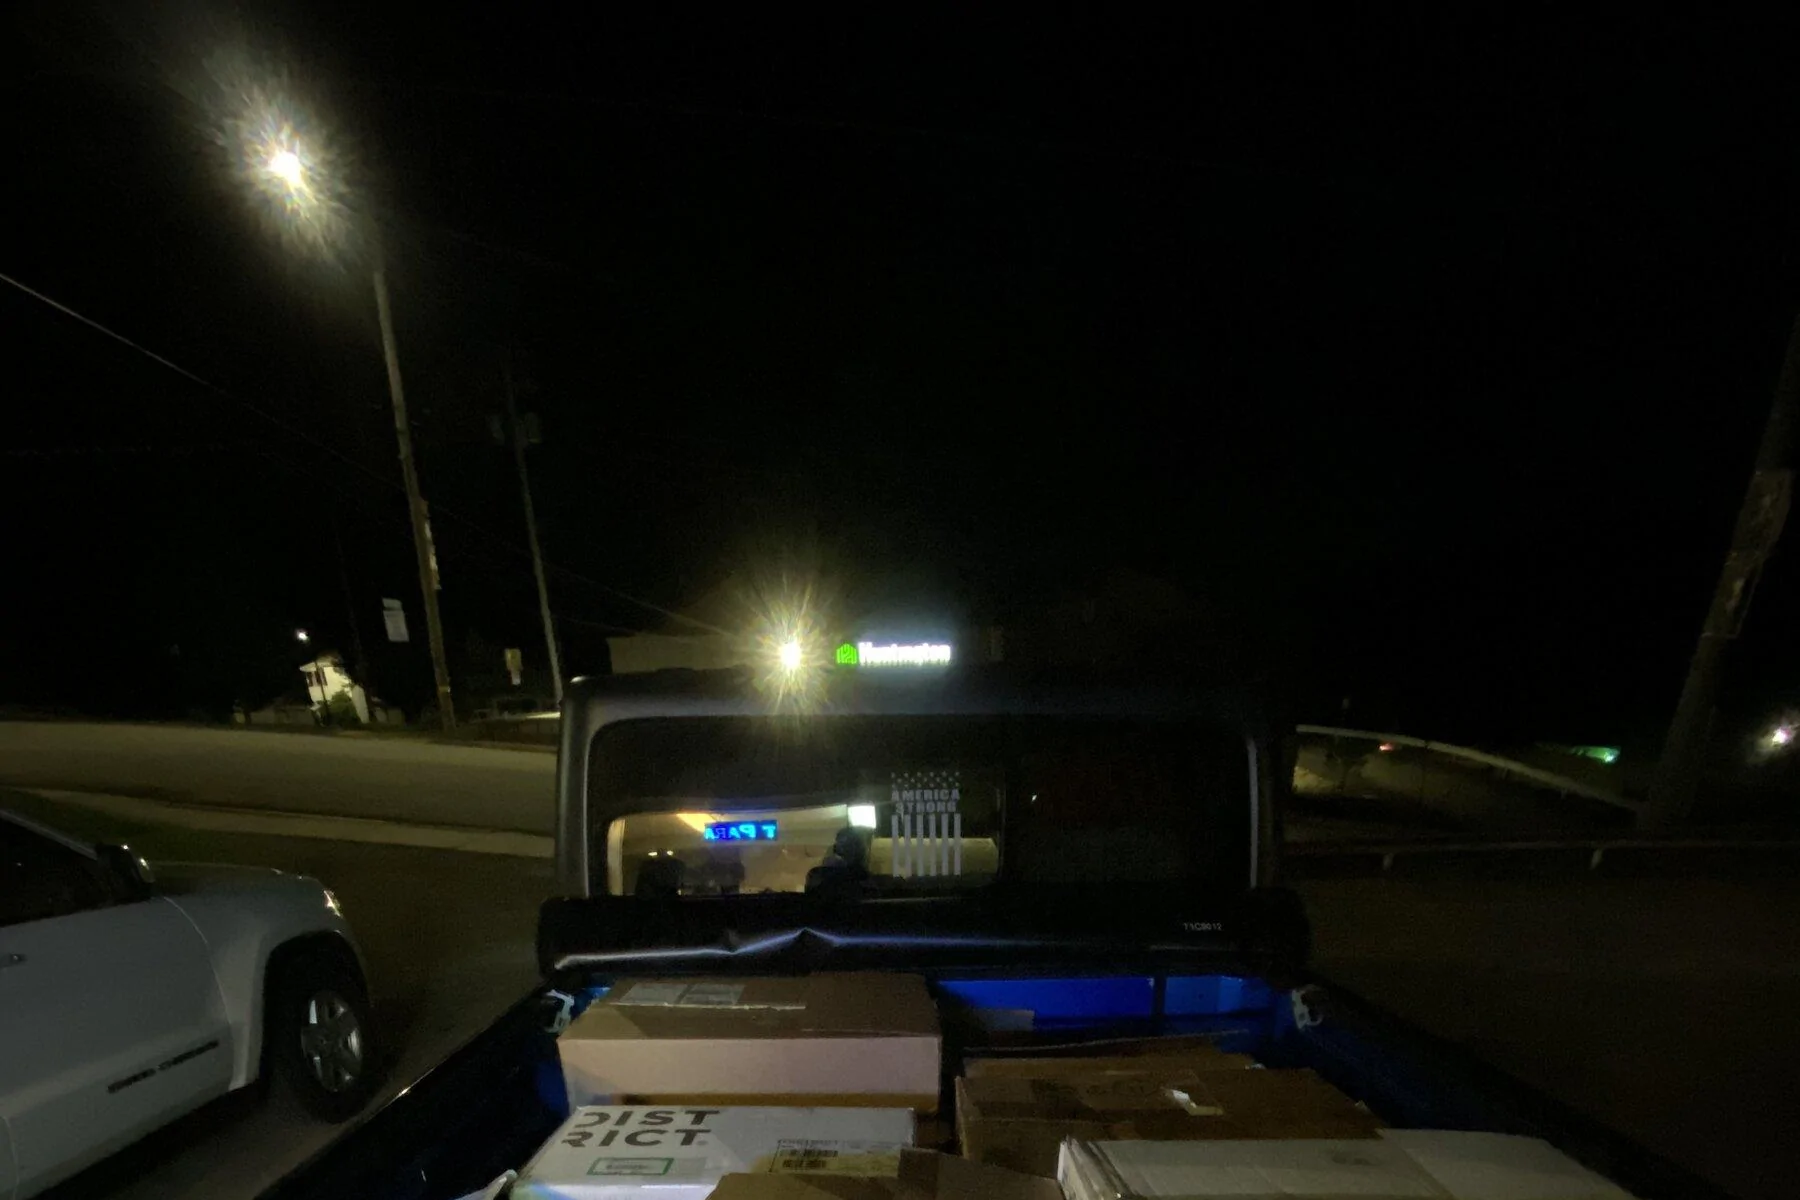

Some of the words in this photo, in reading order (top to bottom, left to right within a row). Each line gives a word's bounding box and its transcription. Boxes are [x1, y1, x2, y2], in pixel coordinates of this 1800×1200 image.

[891, 788, 960, 801] AMERICA
[896, 801, 957, 813] STRONG
[574, 1110, 720, 1128] DIST
